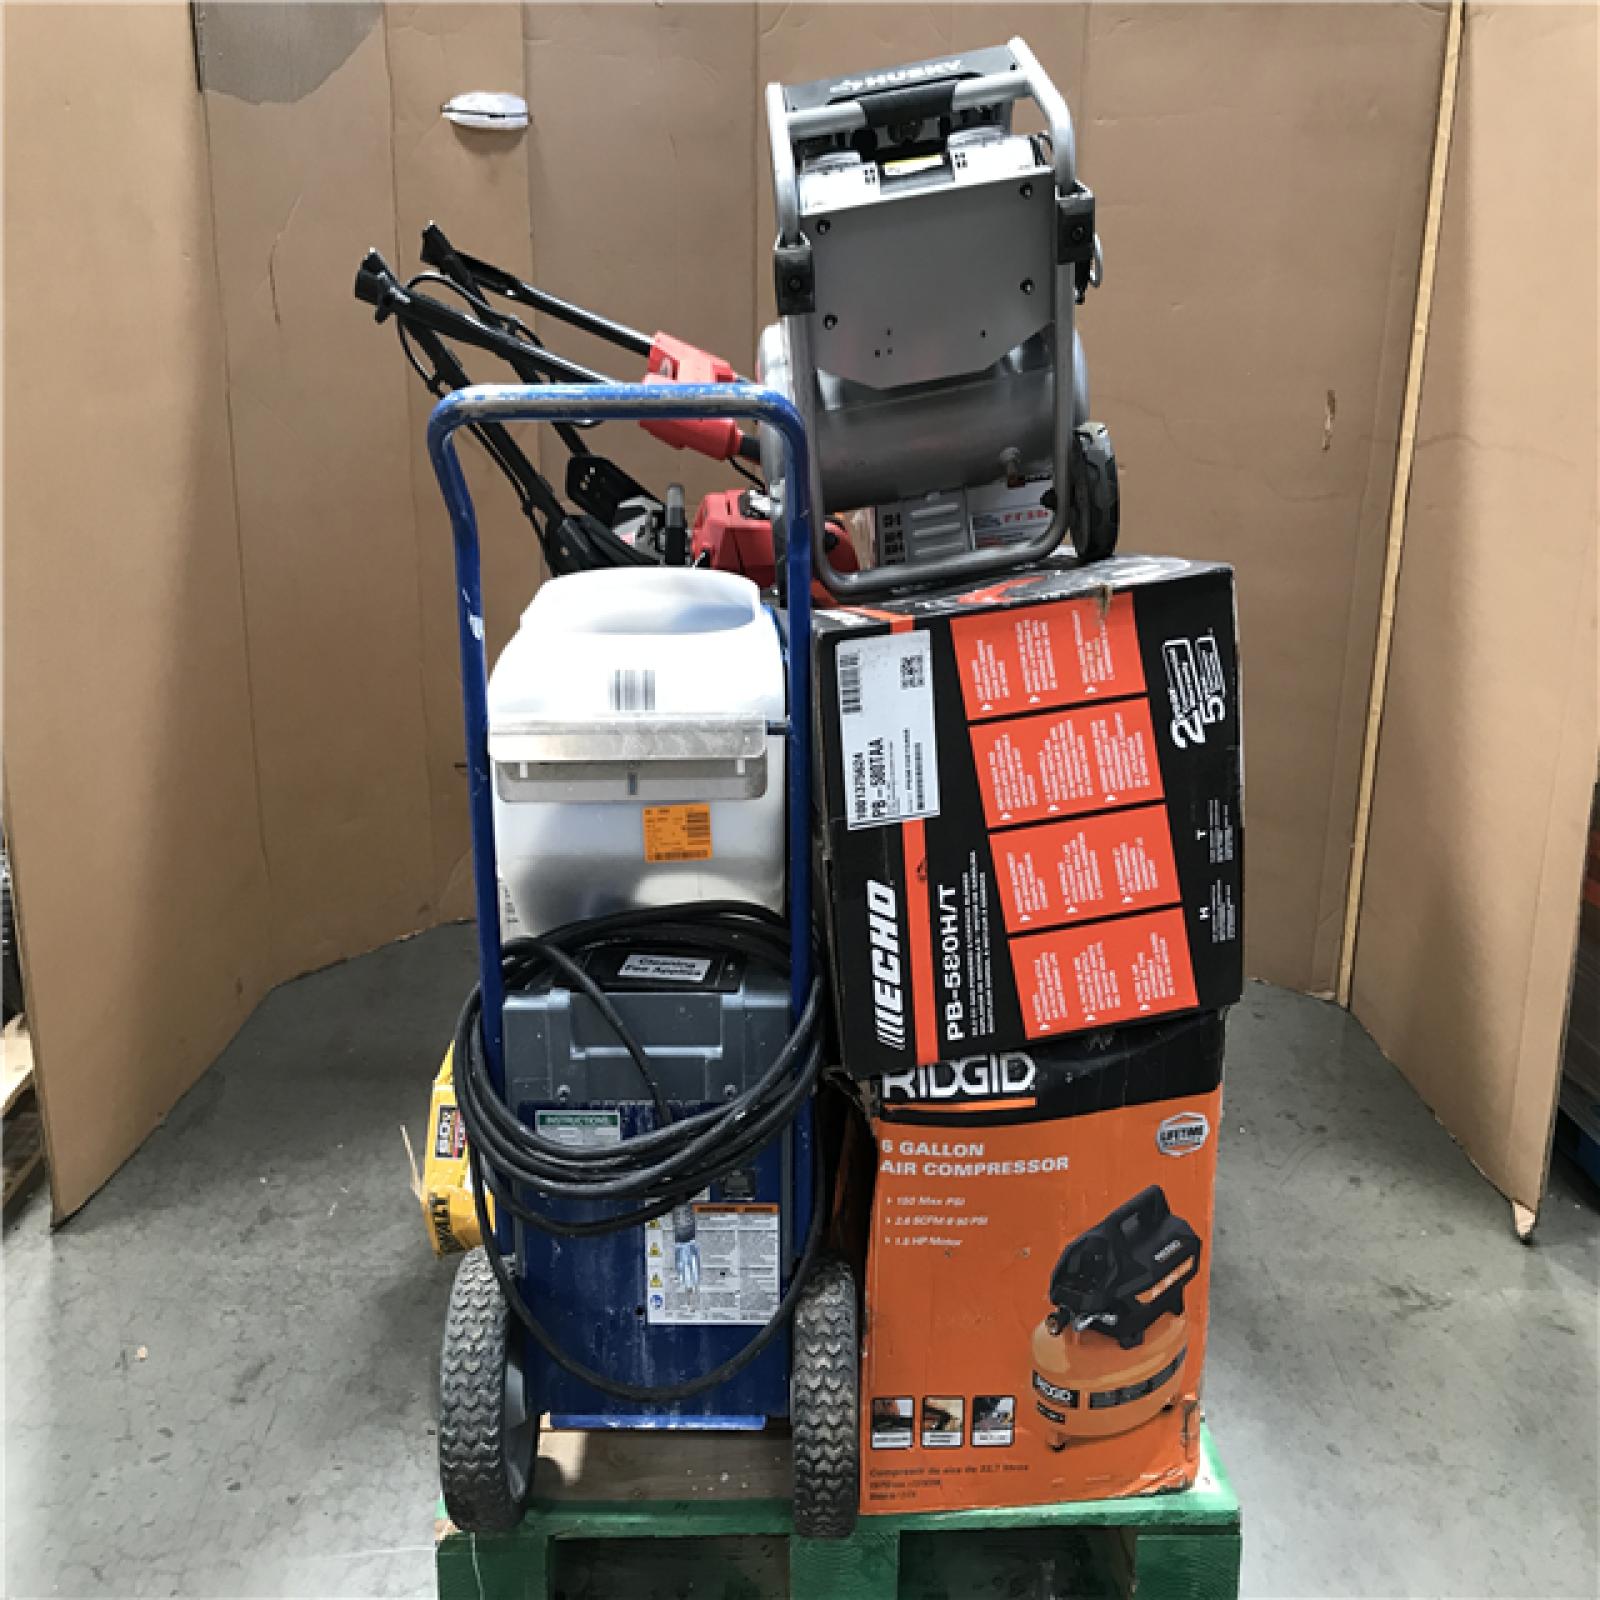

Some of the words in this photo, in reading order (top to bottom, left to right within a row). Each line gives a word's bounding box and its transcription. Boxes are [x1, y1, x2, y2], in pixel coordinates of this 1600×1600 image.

[864, 60, 961, 88] HUSKY
[867, 880, 904, 1014] ECHO
[937, 885, 966, 1041] PB-580H/T
[882, 1052, 1035, 1098] RIDGID
[880, 1159, 917, 1176] AIR
[923, 1155, 1069, 1177] COMPRESSOR
[899, 1140, 984, 1158] GALLON
